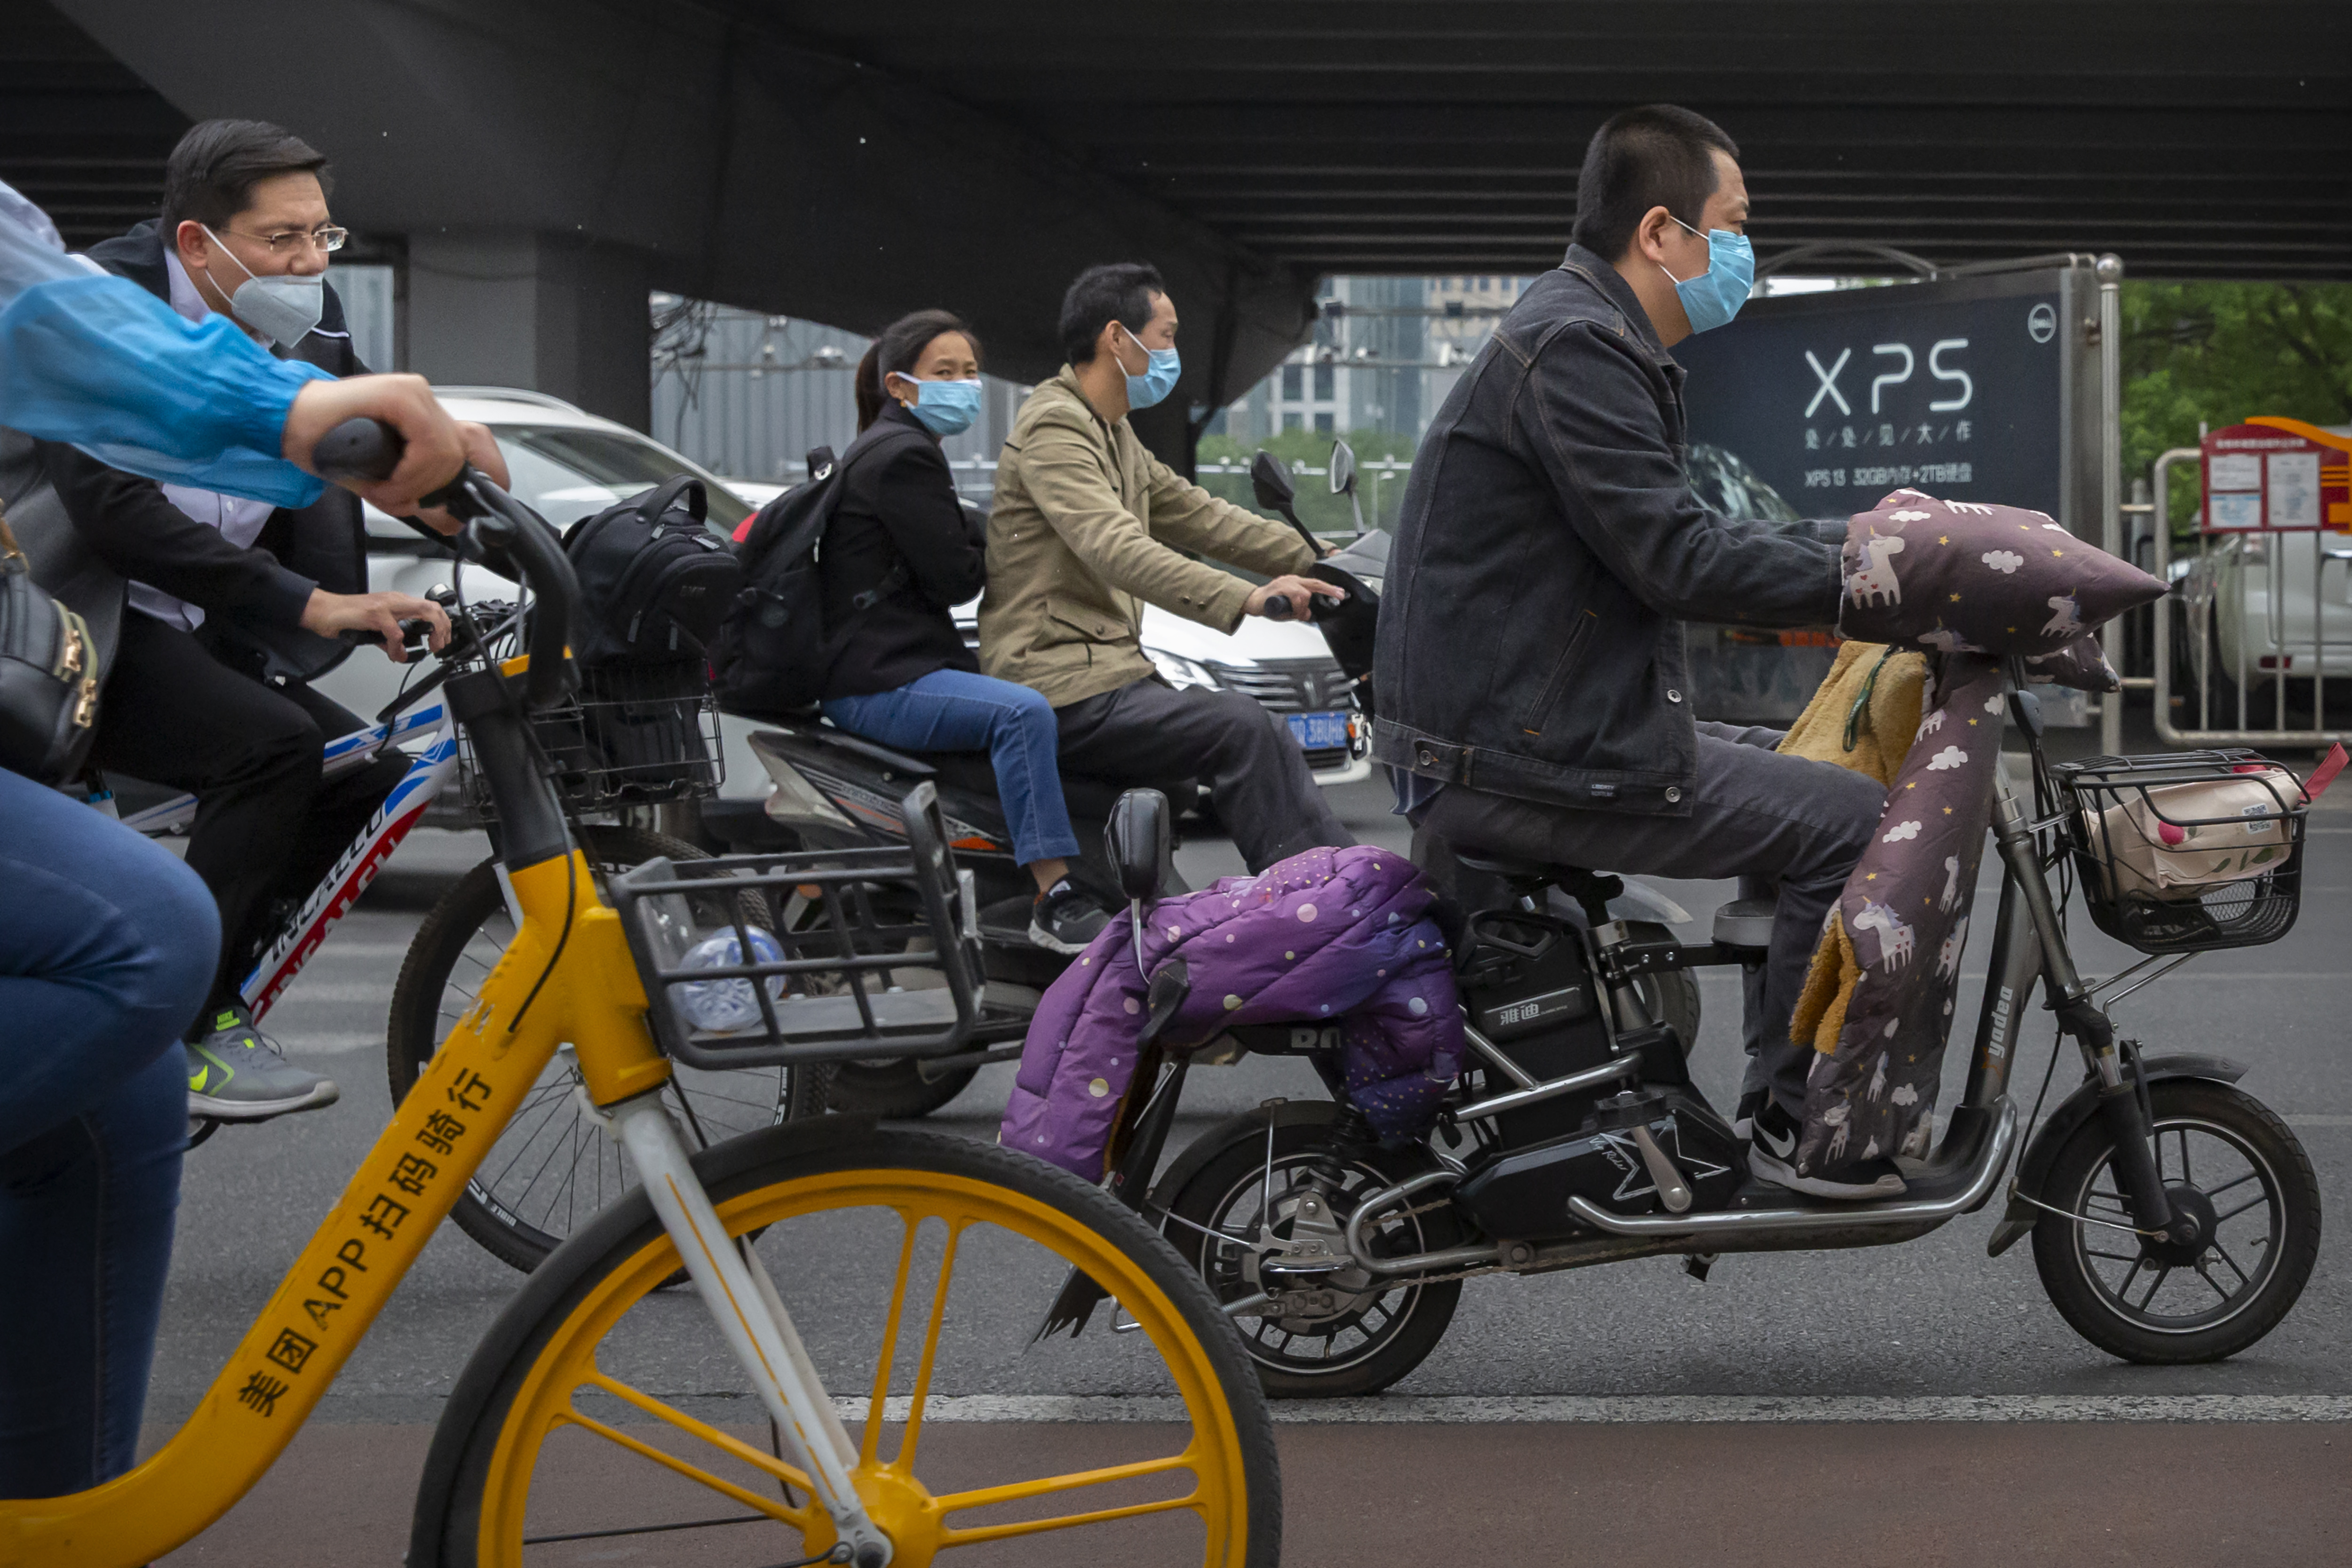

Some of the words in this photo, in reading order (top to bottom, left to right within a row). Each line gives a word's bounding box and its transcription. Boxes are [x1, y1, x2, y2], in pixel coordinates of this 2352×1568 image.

[1805, 338, 1972, 418] XPS
[1804, 469, 1831, 487] XPS
[1501, 1003, 1541, 1025] 雅迪
[238, 1068, 492, 1417] 美团APP扫码骑行
